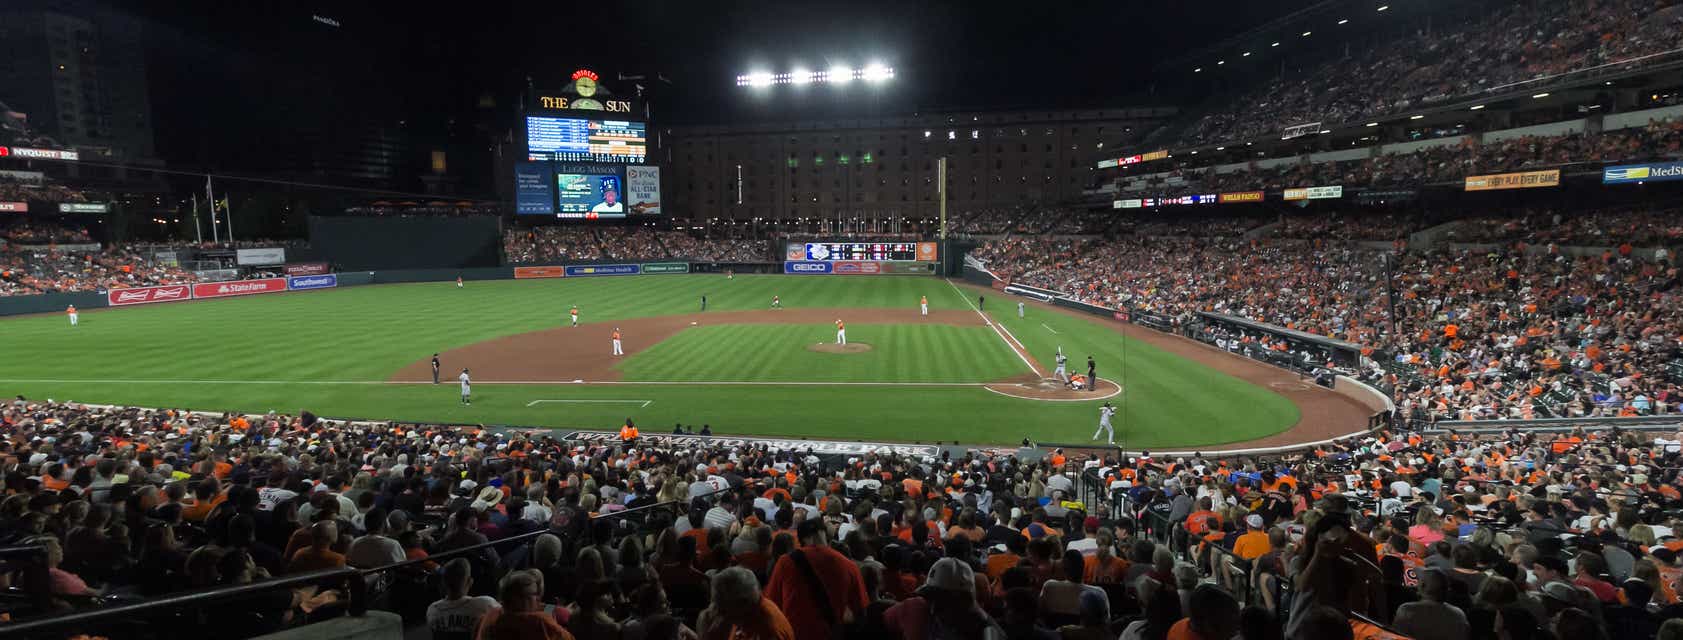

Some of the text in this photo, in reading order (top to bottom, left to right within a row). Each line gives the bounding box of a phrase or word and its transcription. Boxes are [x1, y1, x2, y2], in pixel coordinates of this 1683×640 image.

[571, 69, 599, 81] ORIOLES
[541, 97, 631, 112] THE SUN
[563, 165, 617, 174] LEGG MASON
[1651, 166, 1683, 177] MedS
[293, 278, 328, 287] Southwest
